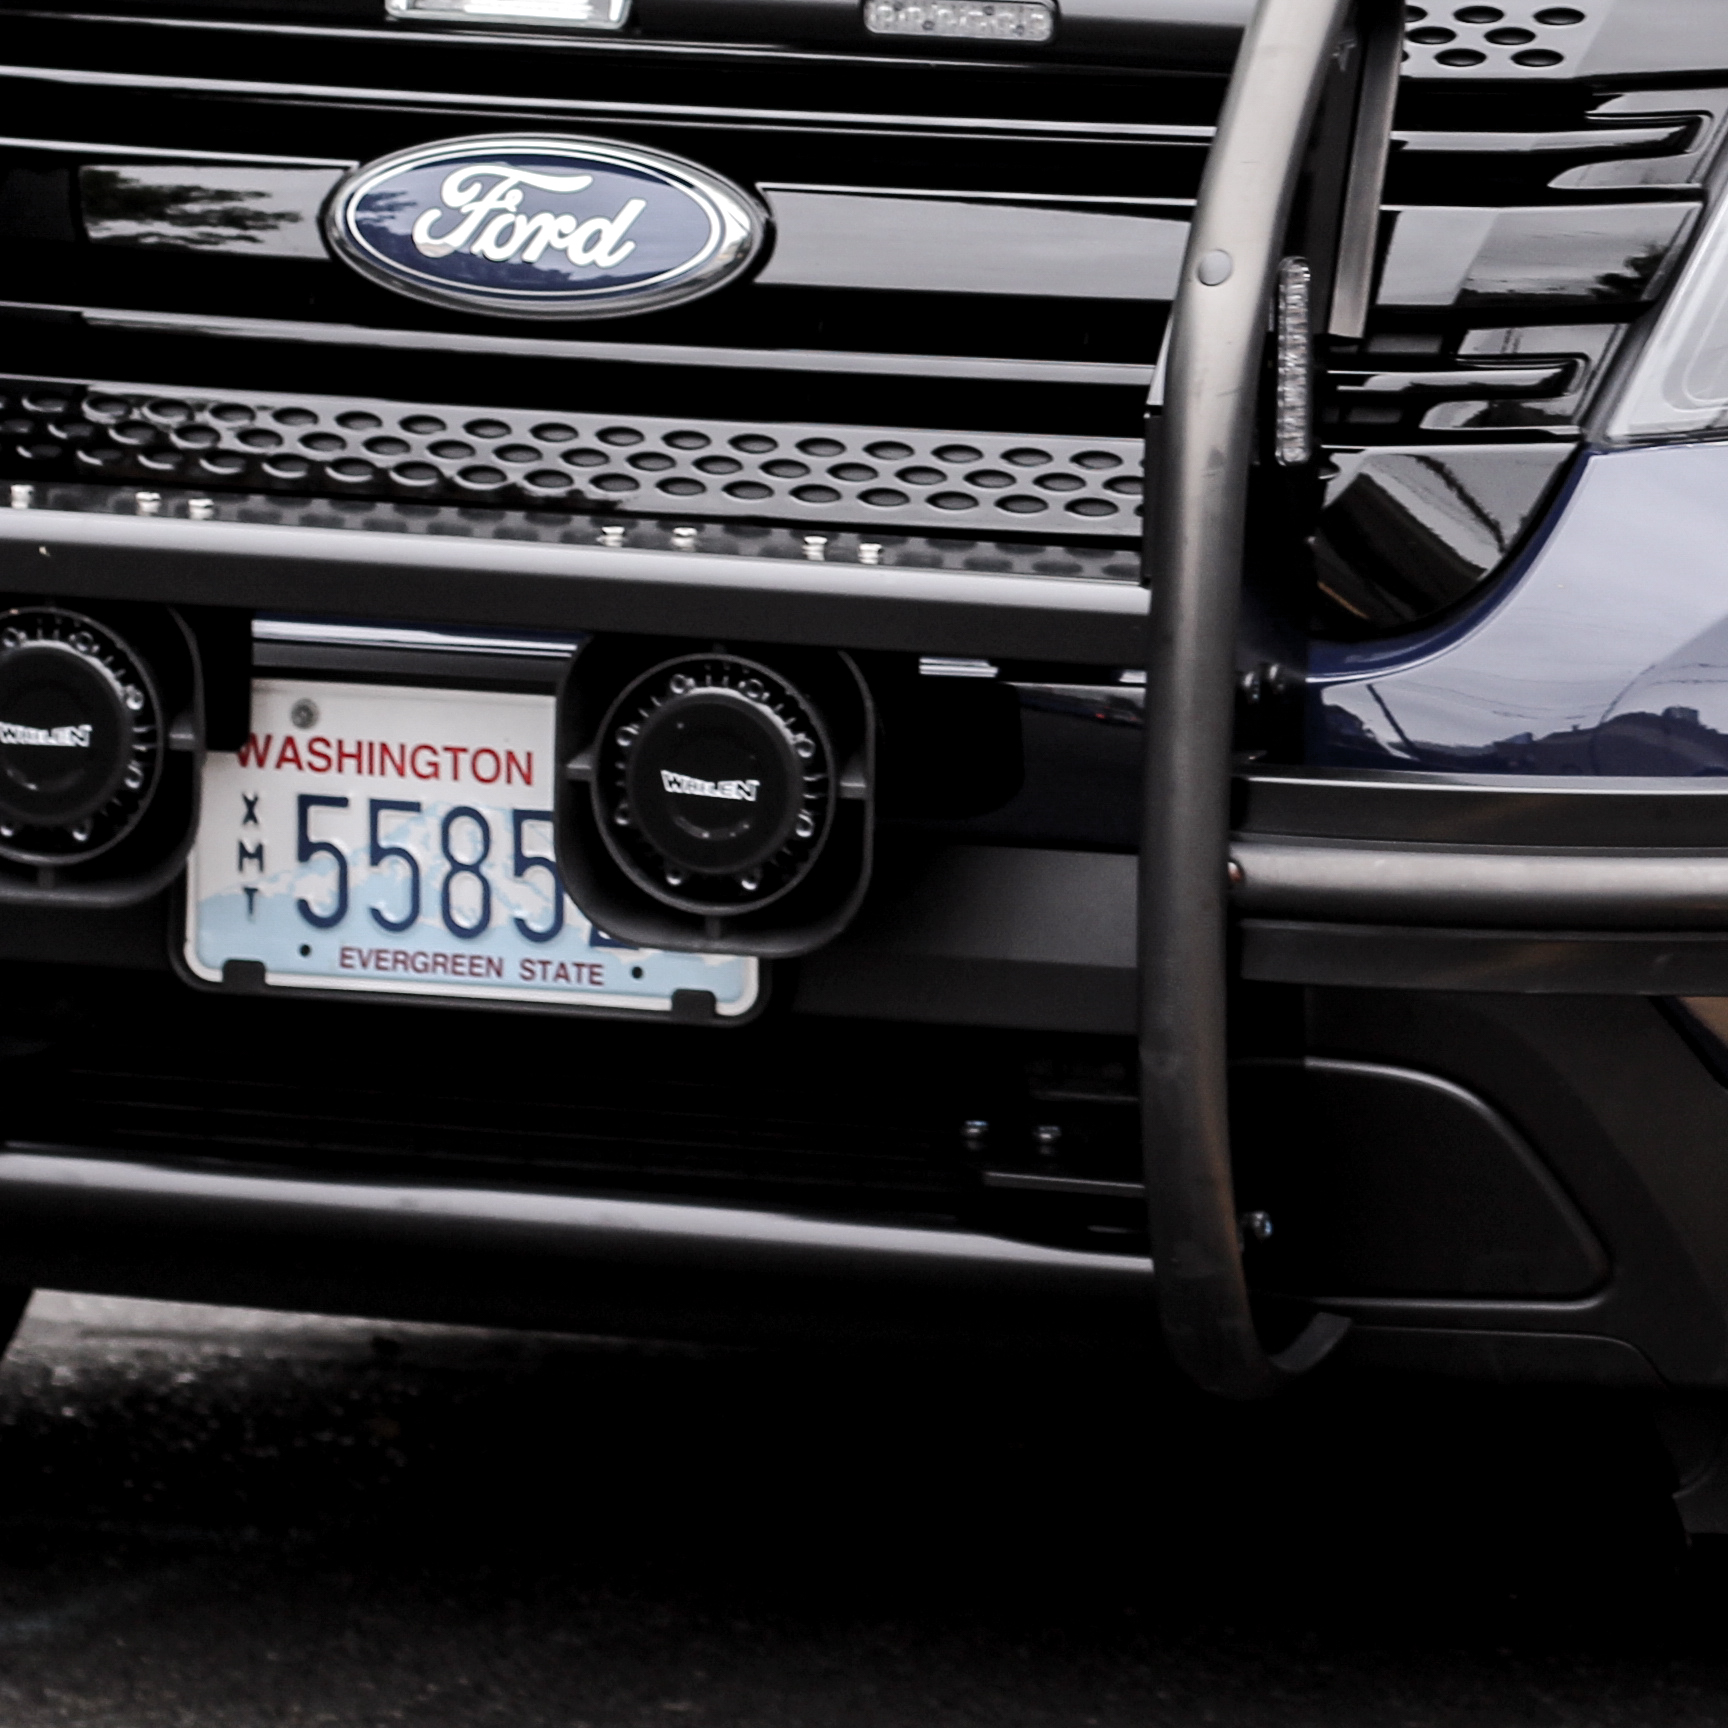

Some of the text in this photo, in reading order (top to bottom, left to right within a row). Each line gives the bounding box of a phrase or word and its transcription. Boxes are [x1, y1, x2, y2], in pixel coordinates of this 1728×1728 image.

[412, 165, 646, 267] Ford
[237, 733, 534, 786] WASHINGTON
[297, 793, 640, 950] 5585
[339, 946, 605, 986] EVERGREEN STATE
